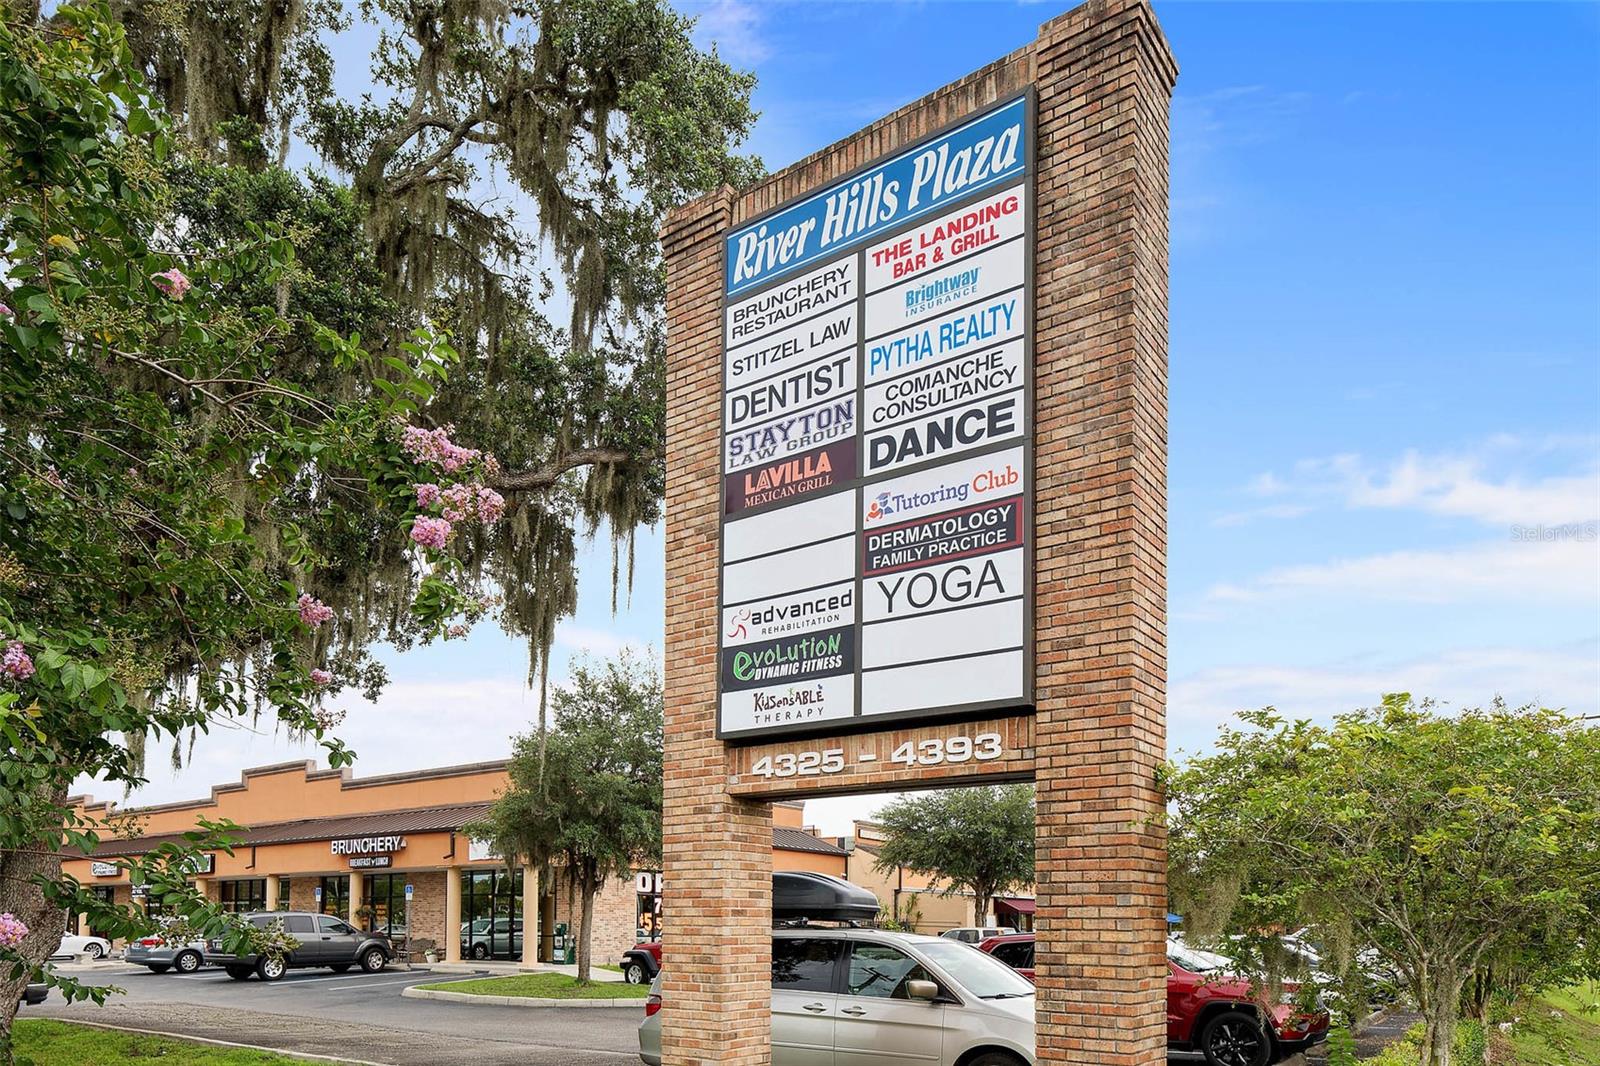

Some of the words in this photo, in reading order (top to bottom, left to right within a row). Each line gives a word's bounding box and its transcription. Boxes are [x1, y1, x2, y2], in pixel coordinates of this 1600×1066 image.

[734, 216, 816, 285] River
[820, 172, 900, 248] Hills
[908, 123, 1021, 212] Plaza
[872, 238, 912, 267] THE
[920, 196, 1018, 248] LANDING
[893, 252, 926, 279] BAR
[933, 245, 944, 263] &
[951, 224, 999, 255] GRILL
[732, 280, 851, 340] RESTAURANT
[733, 263, 850, 324] BRUNCHERY
[905, 267, 980, 308] Brightway
[905, 285, 978, 318] INSURANCE
[732, 338, 804, 377] STITZEL
[810, 316, 851, 348] LAW
[870, 330, 933, 376] PYTHA
[939, 299, 1016, 354] REALTY
[731, 356, 851, 425] DENTIST
[872, 365, 1018, 423] CONSULTANCY
[885, 350, 1004, 401] COMANCHE
[729, 399, 855, 458] STAYTON
[729, 446, 778, 470] LAW
[786, 422, 853, 452] GROUP
[869, 398, 1016, 470] DANCE
[744, 484, 797, 508] MEXICAN
[797, 474, 833, 493] GRILL
[745, 451, 832, 496] LAVILLA
[892, 483, 970, 513] Tutoring
[972, 465, 1019, 494] Club
[868, 505, 1012, 552] DERMATOLOGY
[872, 547, 925, 569] FAMILY
[928, 528, 1007, 557] PRACTICE
[751, 589, 852, 625] advanced
[877, 559, 1006, 613] YOGA
[761, 613, 840, 635] REHABILITATION
[754, 661, 800, 681] DYNAMIC
[801, 655, 843, 674] FITNESS
[754, 706, 824, 724] THERAPY
[752, 748, 844, 779] 4325
[891, 732, 1003, 767] 4393
[330, 835, 401, 855] BRUNCHERY
